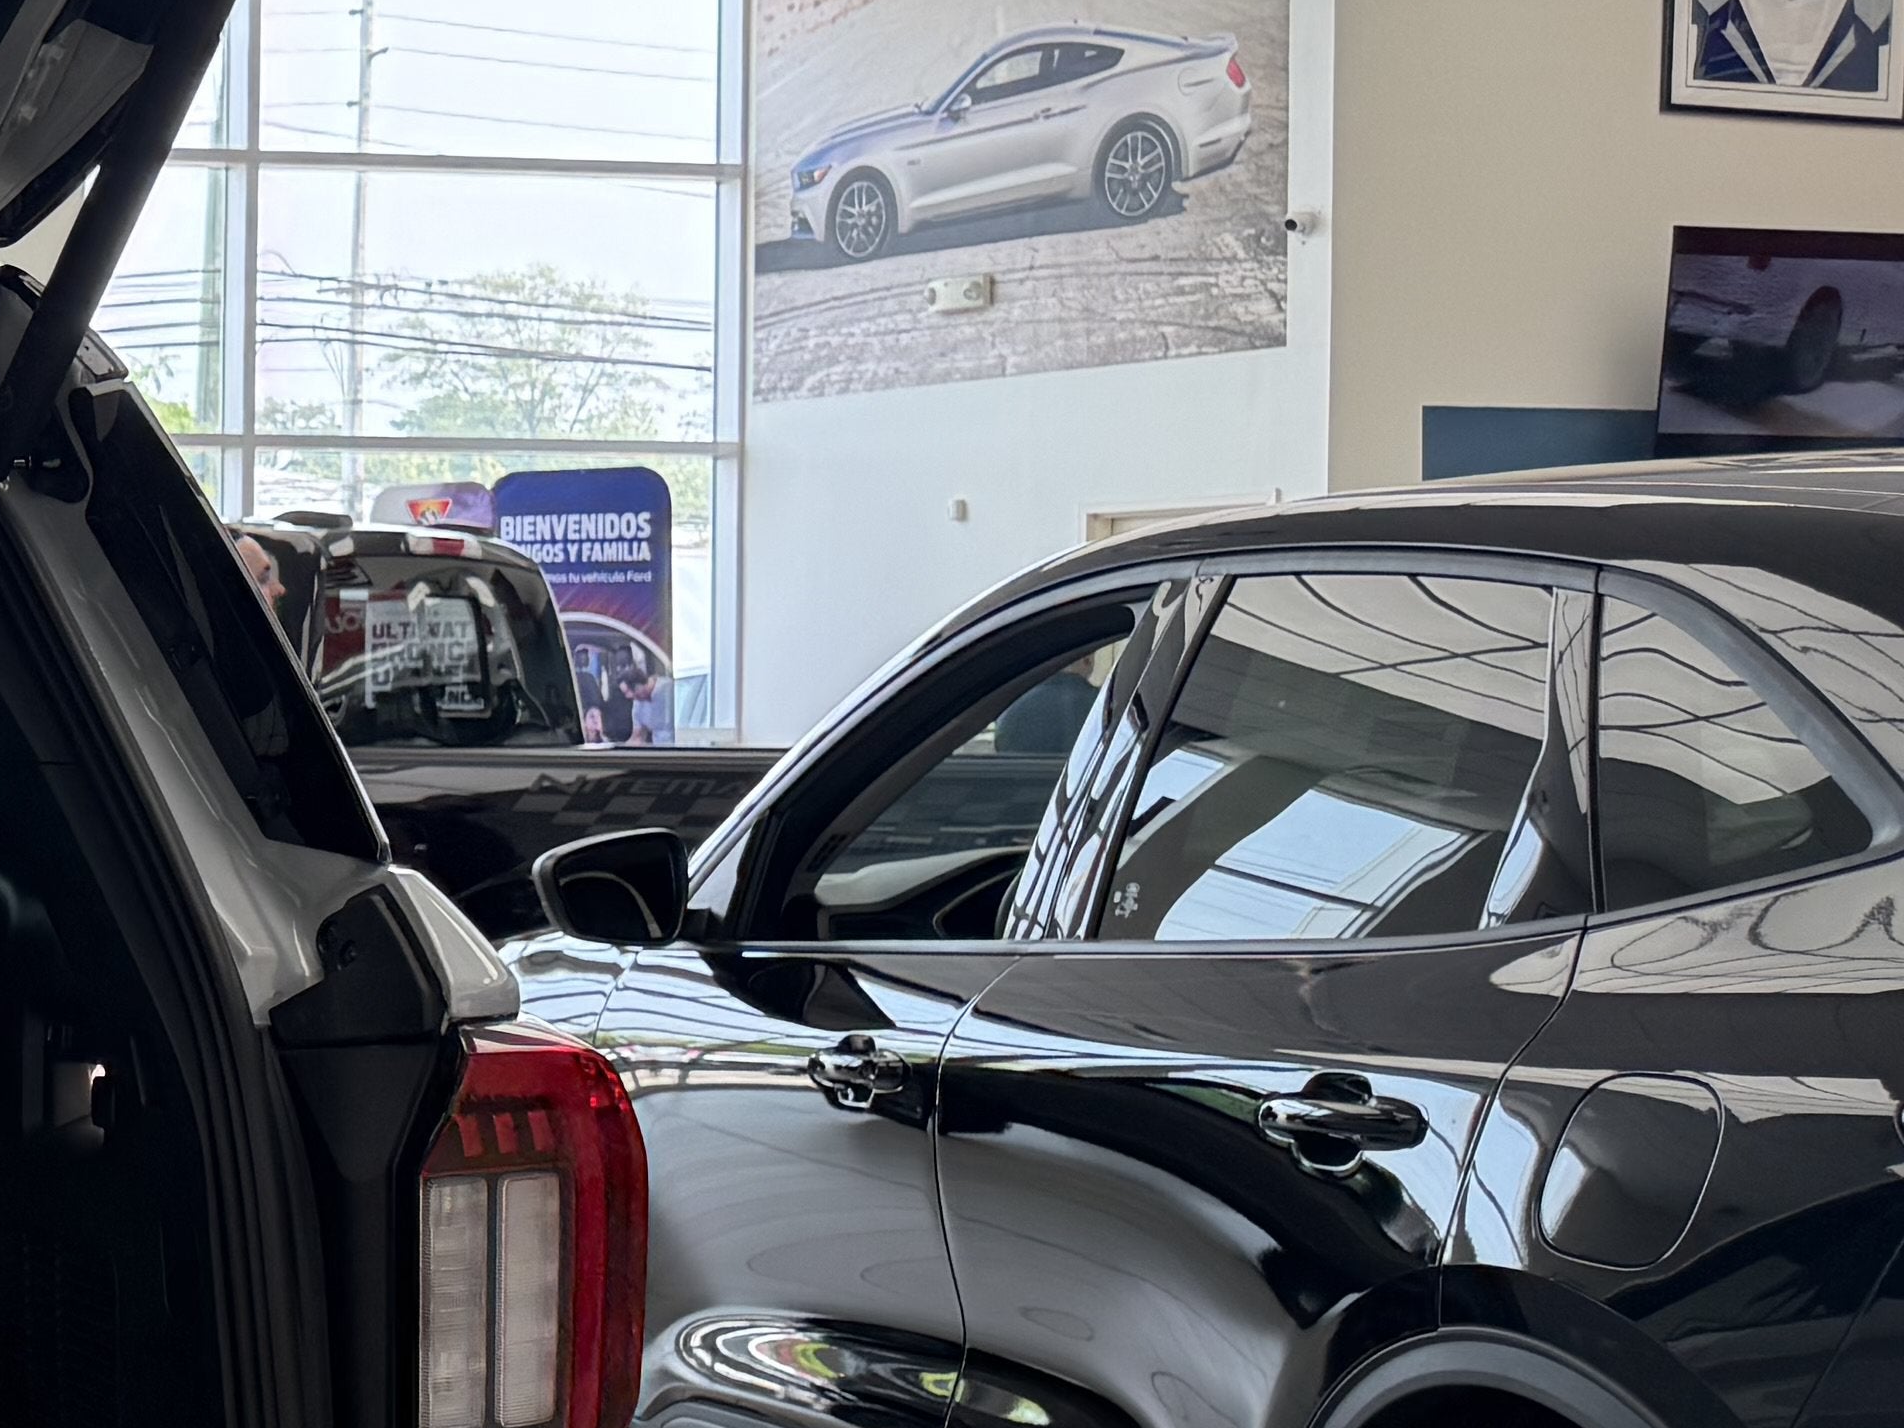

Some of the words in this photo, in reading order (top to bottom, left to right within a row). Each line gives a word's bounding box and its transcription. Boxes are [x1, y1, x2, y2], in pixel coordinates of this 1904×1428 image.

[500, 511, 651, 542] BIENVENIDOS
[516, 543, 564, 564] IGOS
[567, 543, 580, 563] Y
[581, 541, 651, 563] FAMILIA
[626, 570, 652, 583] Ford
[372, 622, 468, 639] ULTIMAT
[528, 772, 752, 794] NITEMA
